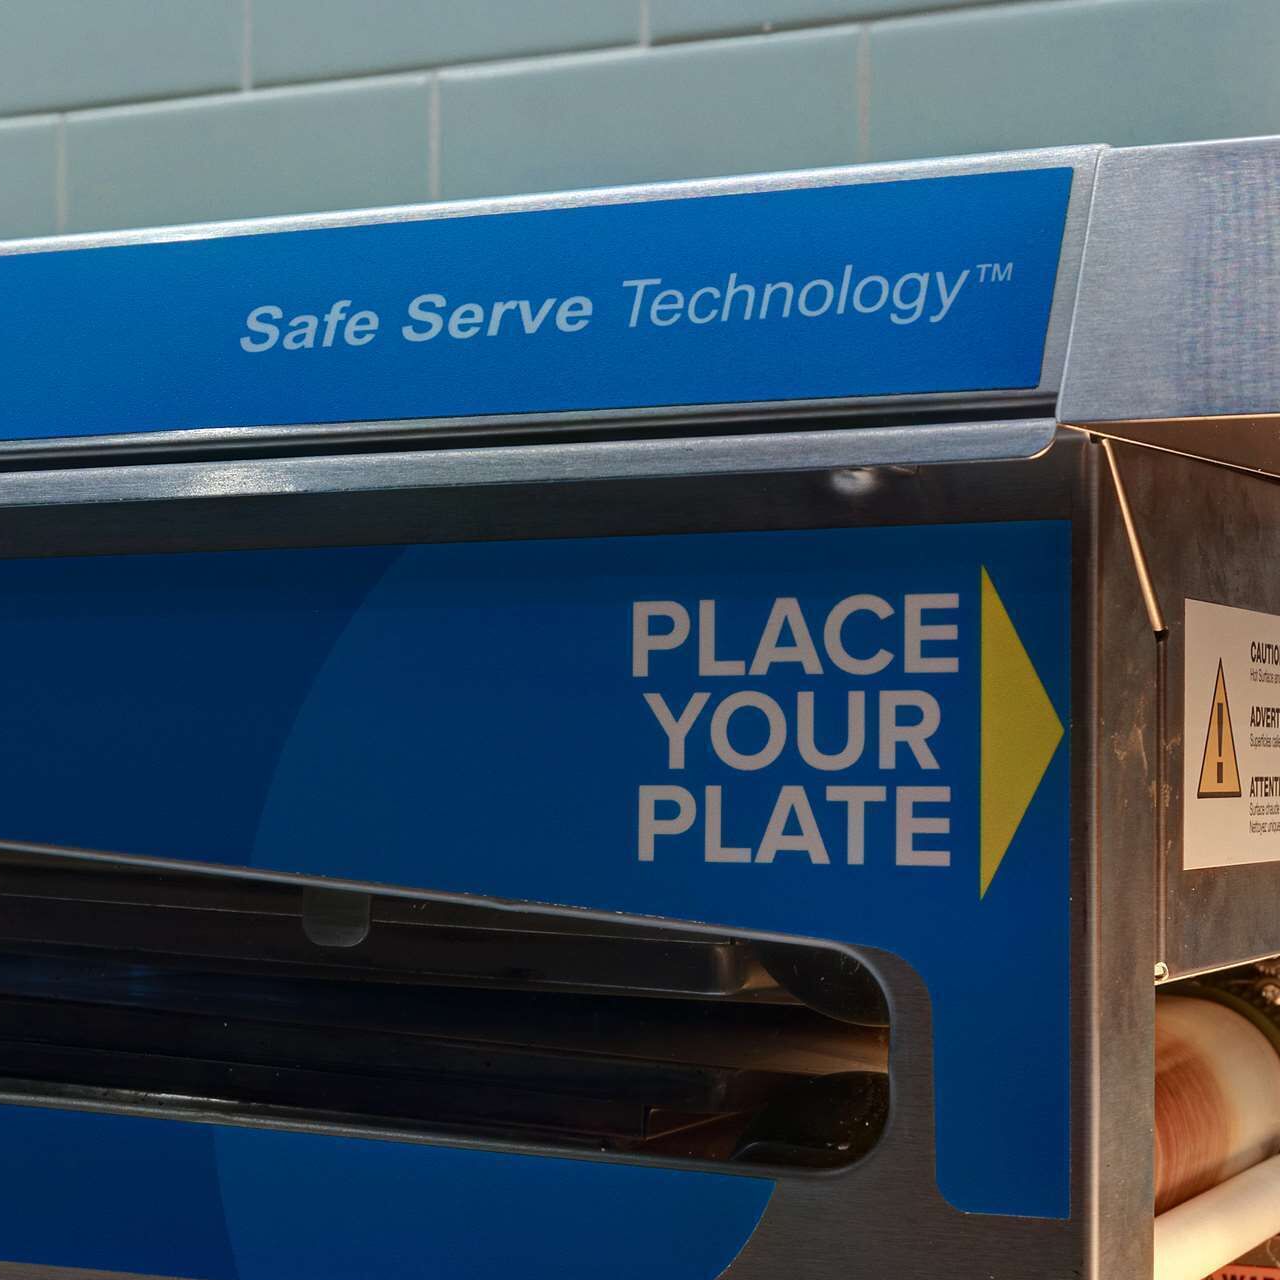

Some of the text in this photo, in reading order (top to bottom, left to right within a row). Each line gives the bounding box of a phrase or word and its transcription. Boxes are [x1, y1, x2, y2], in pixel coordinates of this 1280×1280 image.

[240, 301, 380, 353] Safe
[402, 293, 593, 344] Serve
[633, 593, 959, 677] PLACE
[642, 690, 941, 771] YOUR
[638, 784, 951, 866] PLATE
